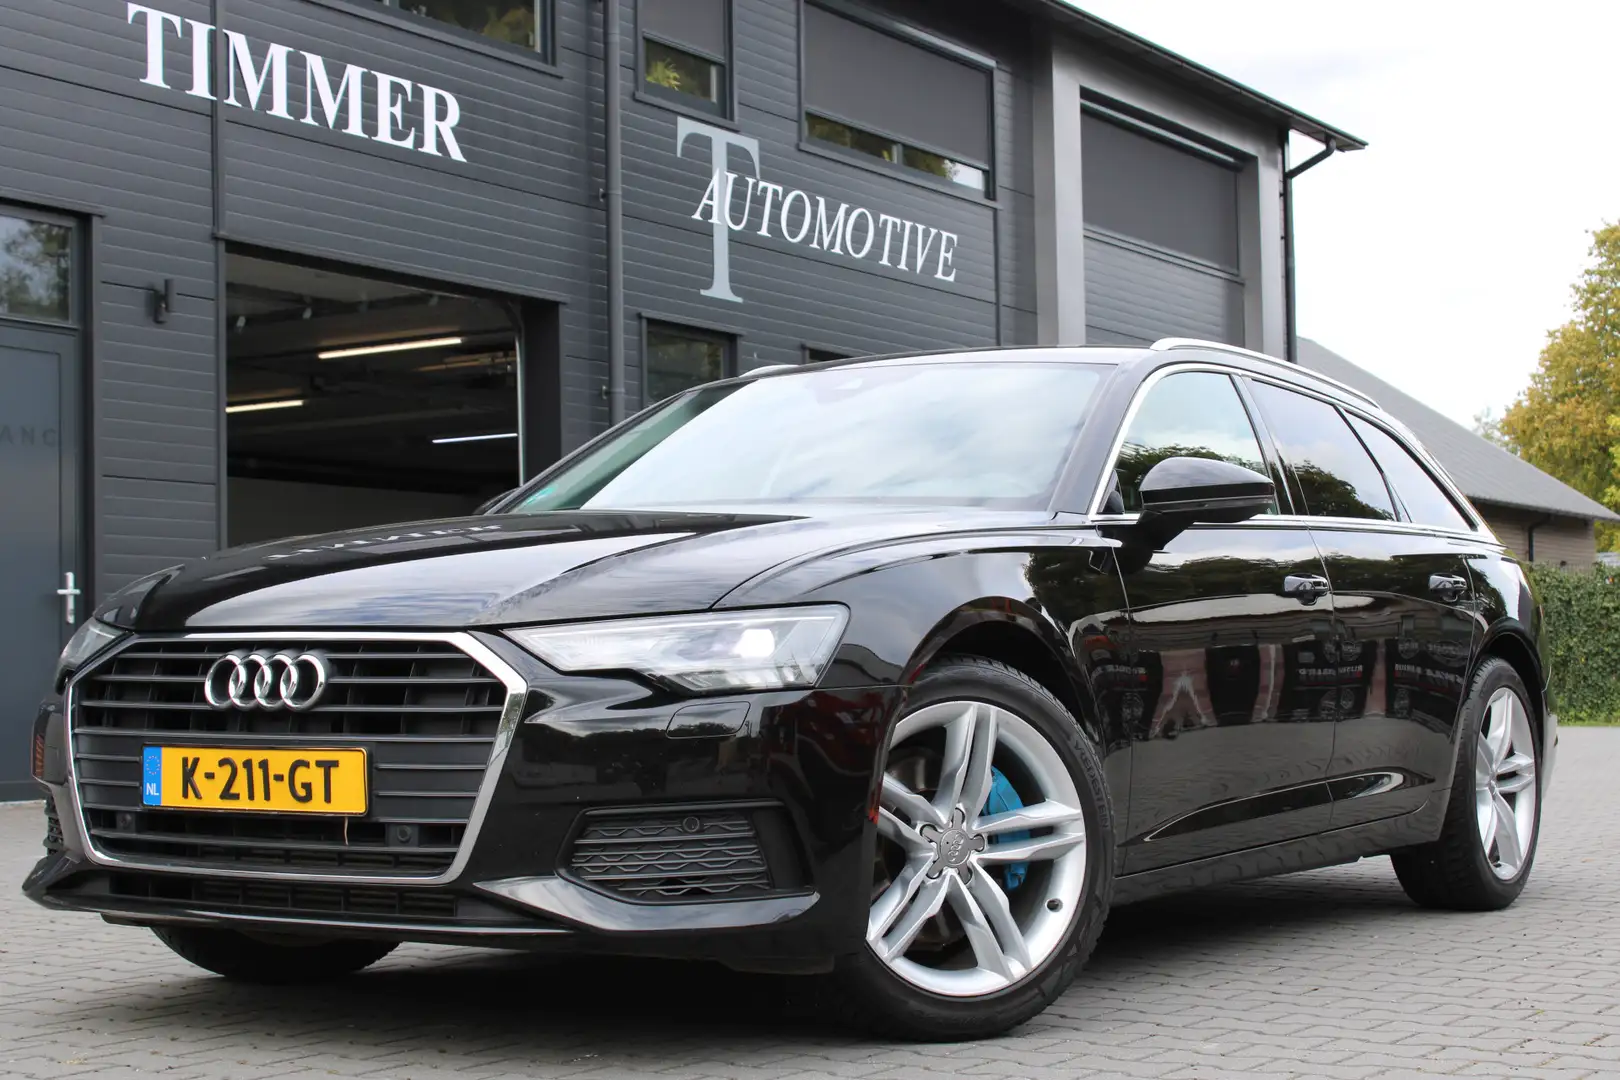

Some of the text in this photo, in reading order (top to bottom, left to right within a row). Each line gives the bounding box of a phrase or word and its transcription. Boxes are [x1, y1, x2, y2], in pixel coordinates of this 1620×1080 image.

[126, 2, 467, 162] TIMMER
[691, 167, 958, 282] AUTOMOTIVE
[146, 783, 159, 796] NL
[181, 756, 340, 804] K-211-GT
